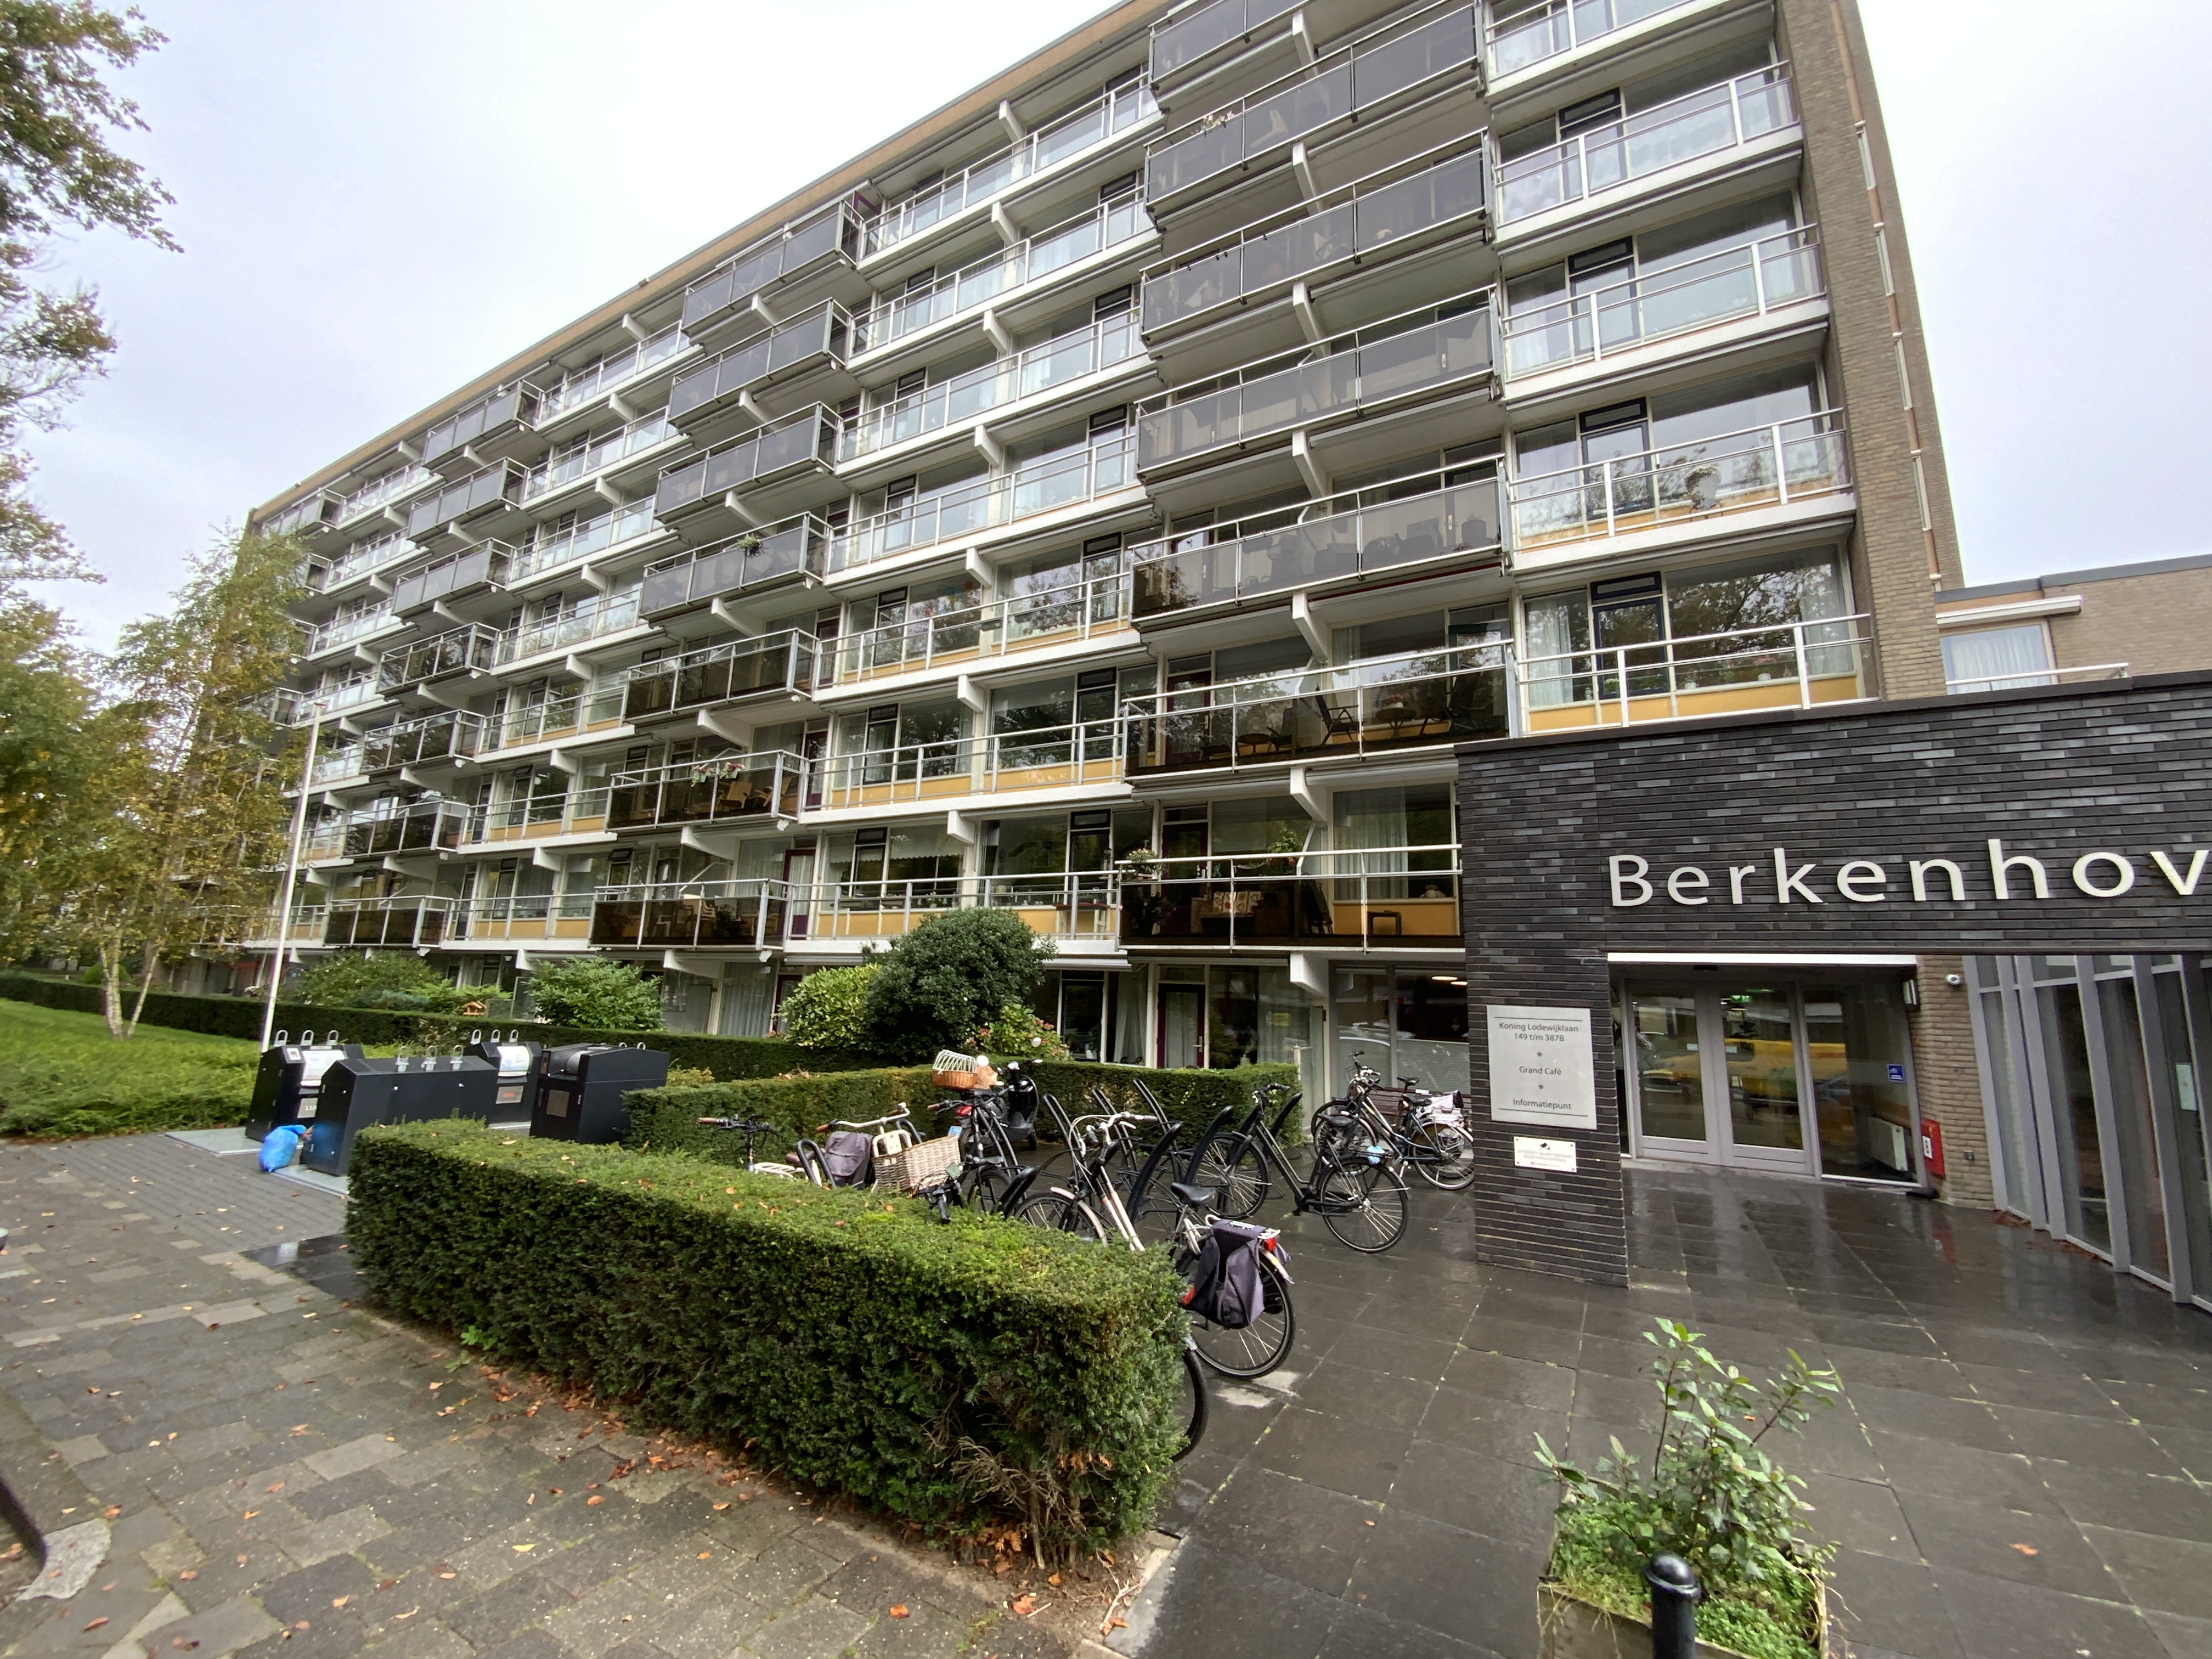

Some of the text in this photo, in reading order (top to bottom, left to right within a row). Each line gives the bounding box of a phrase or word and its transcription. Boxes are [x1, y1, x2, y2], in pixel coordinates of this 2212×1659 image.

[1609, 838, 2210, 907] Berkenhov
[1499, 1022, 1578, 1032] Koning Lodewijklaan
[1519, 1066, 1562, 1075] Grand Café
[1513, 1099, 1571, 1110] Informatiepunt
